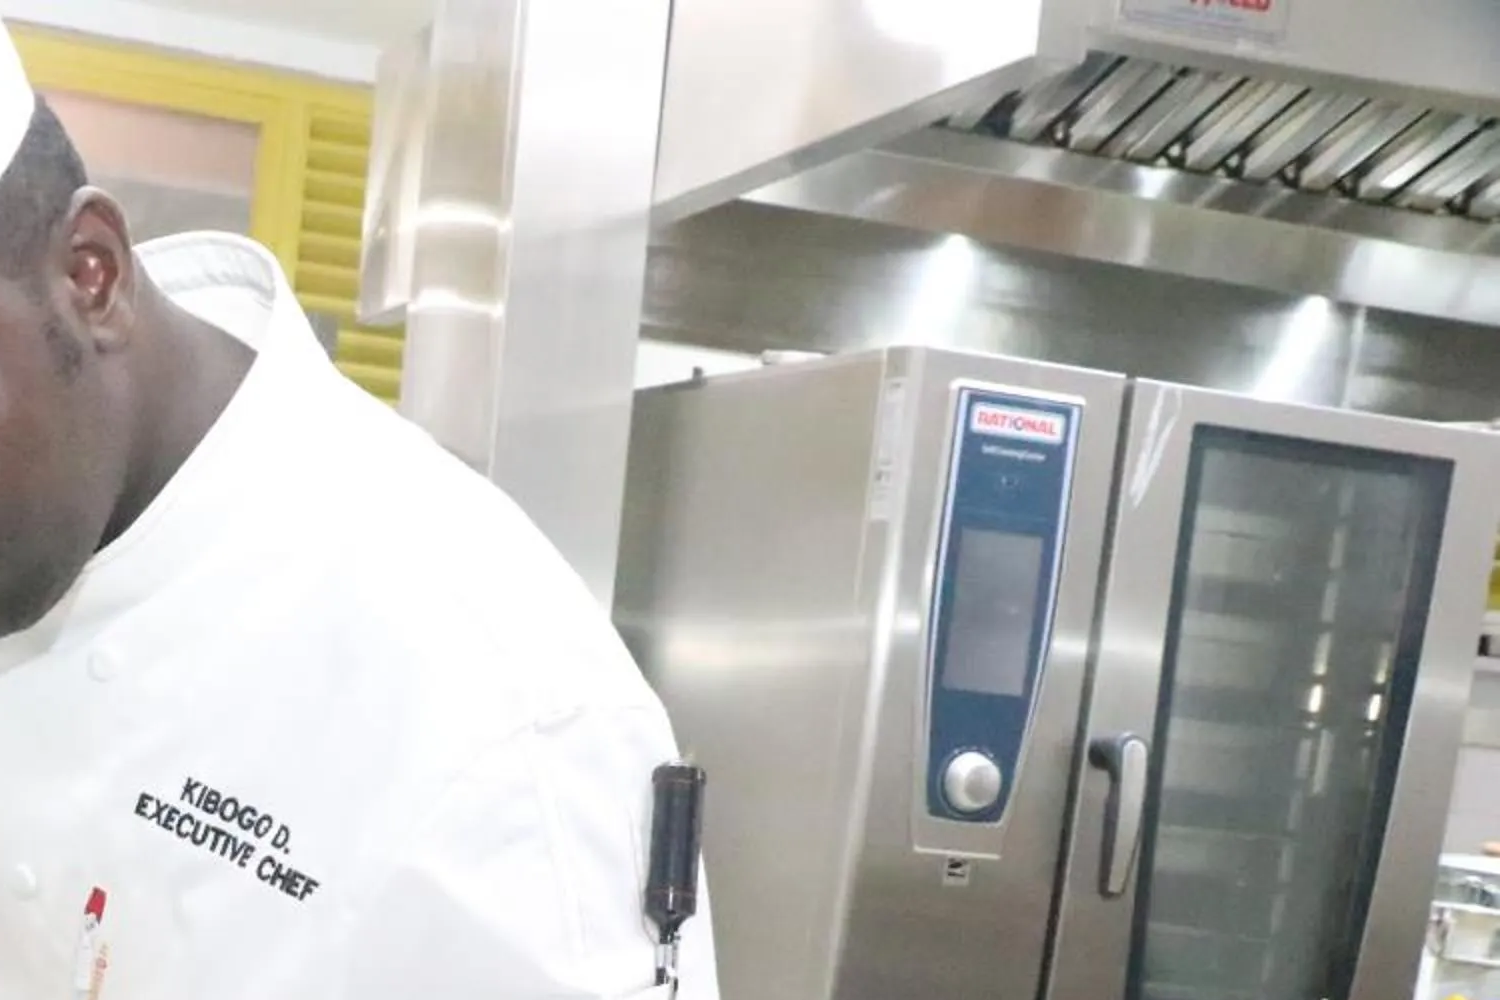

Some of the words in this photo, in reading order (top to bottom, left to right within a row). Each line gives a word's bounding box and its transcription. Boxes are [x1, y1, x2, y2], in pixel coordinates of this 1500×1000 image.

[977, 411, 1057, 436] RATIONAL
[134, 793, 256, 868] EXECUTIVE
[257, 856, 319, 901] CHEF
[181, 777, 273, 838] KIBOGO
[272, 825, 292, 854] D.
